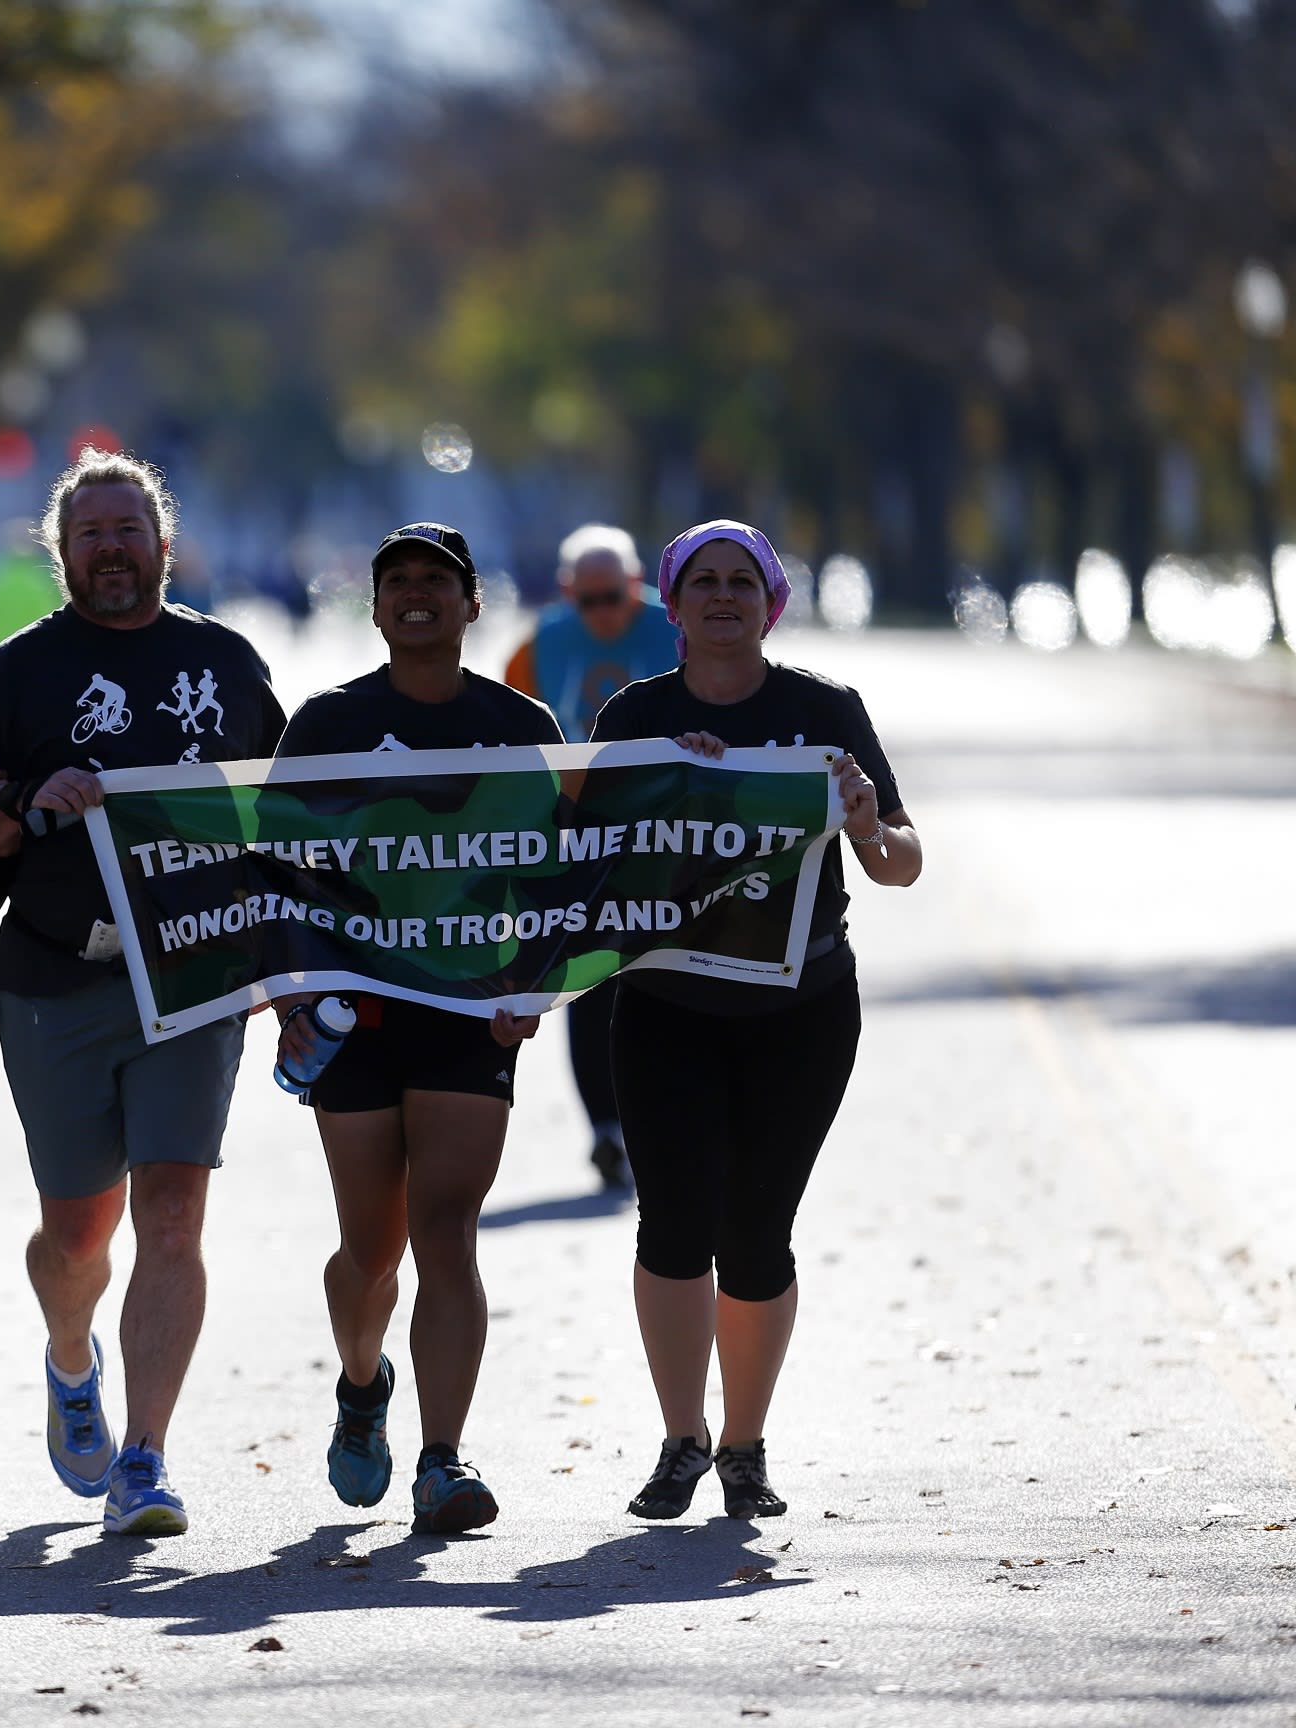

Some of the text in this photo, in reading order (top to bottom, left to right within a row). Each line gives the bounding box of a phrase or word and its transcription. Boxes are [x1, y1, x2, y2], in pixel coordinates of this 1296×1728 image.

[368, 830, 548, 871] TALKED
[558, 824, 628, 863] ME
[632, 819, 746, 858] INTO
[755, 824, 806, 857] IT
[158, 893, 336, 953] HONORING
[344, 914, 427, 949] OUR
[436, 901, 588, 946] TROOPS
[594, 900, 682, 931] AND
